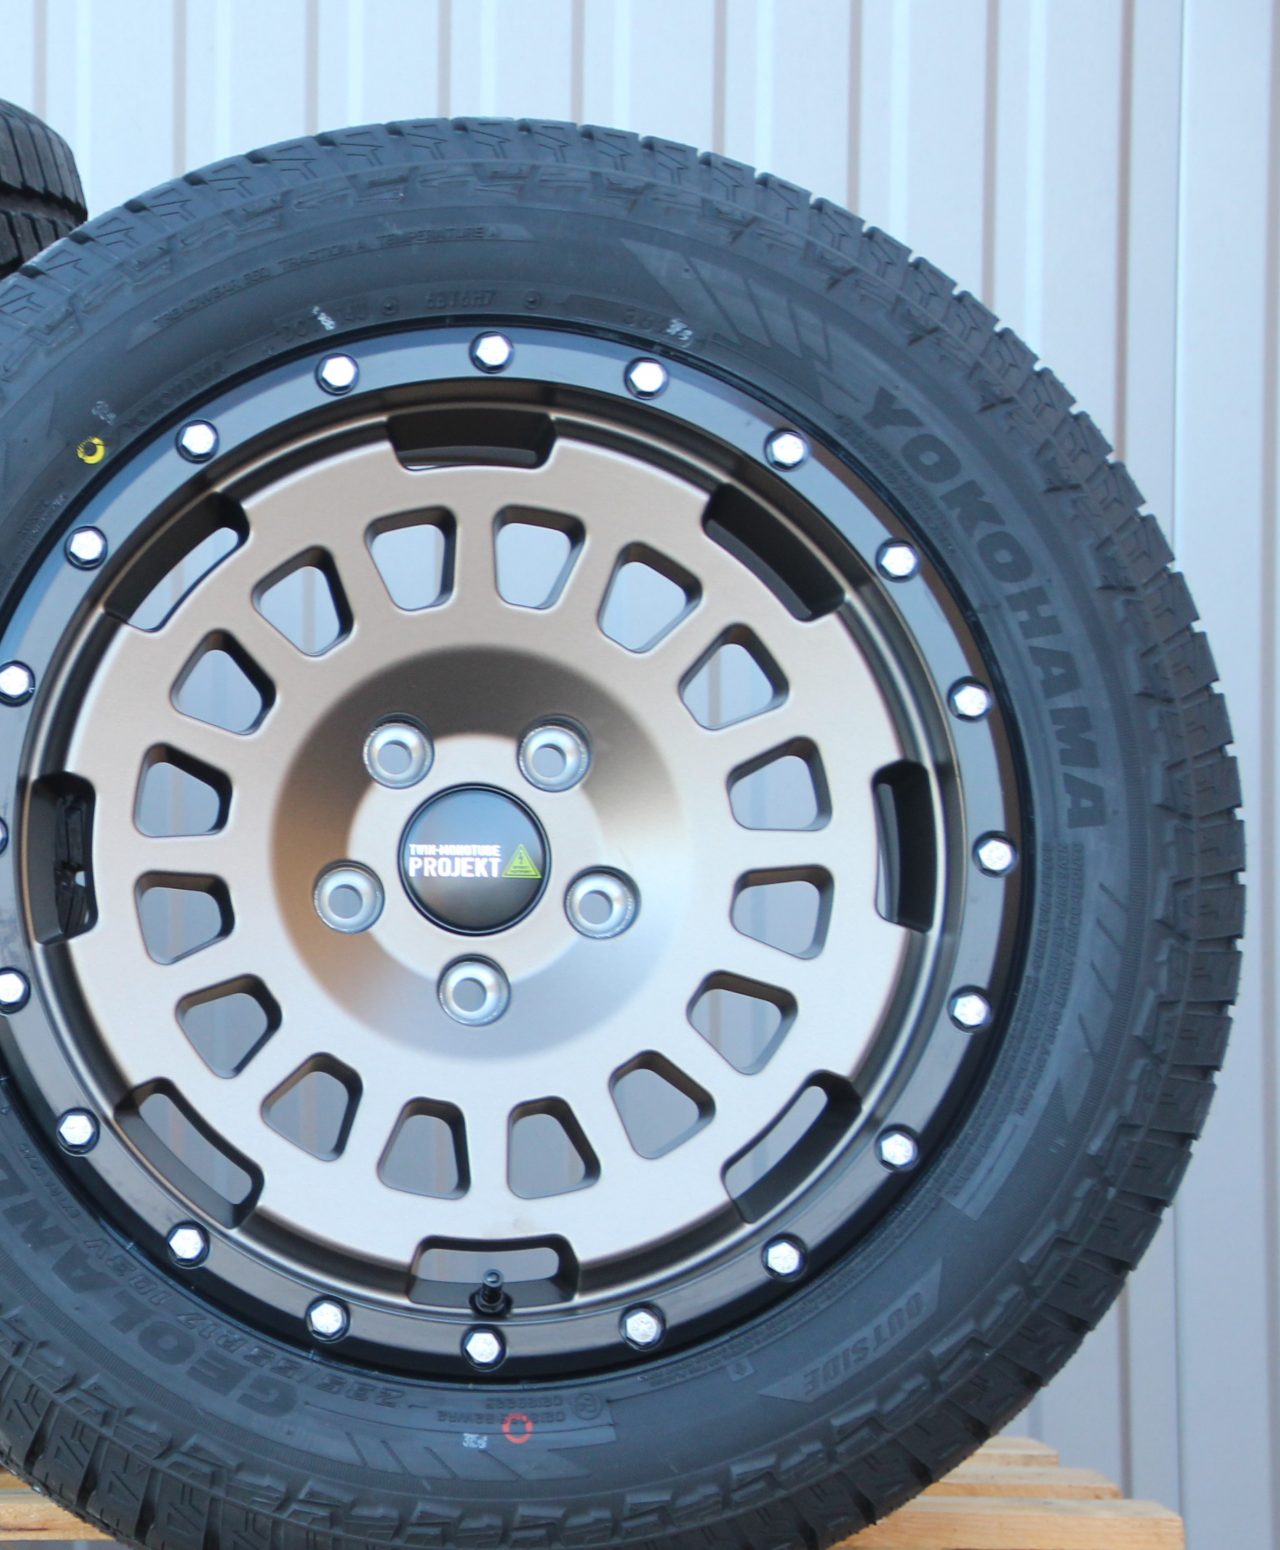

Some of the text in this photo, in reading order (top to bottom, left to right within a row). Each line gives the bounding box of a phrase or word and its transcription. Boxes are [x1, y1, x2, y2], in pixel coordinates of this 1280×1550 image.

[861, 385, 1107, 830] YOKOHAMA
[408, 857, 502, 878] PROJEKT
[803, 1293, 925, 1394] OUTSIDE
